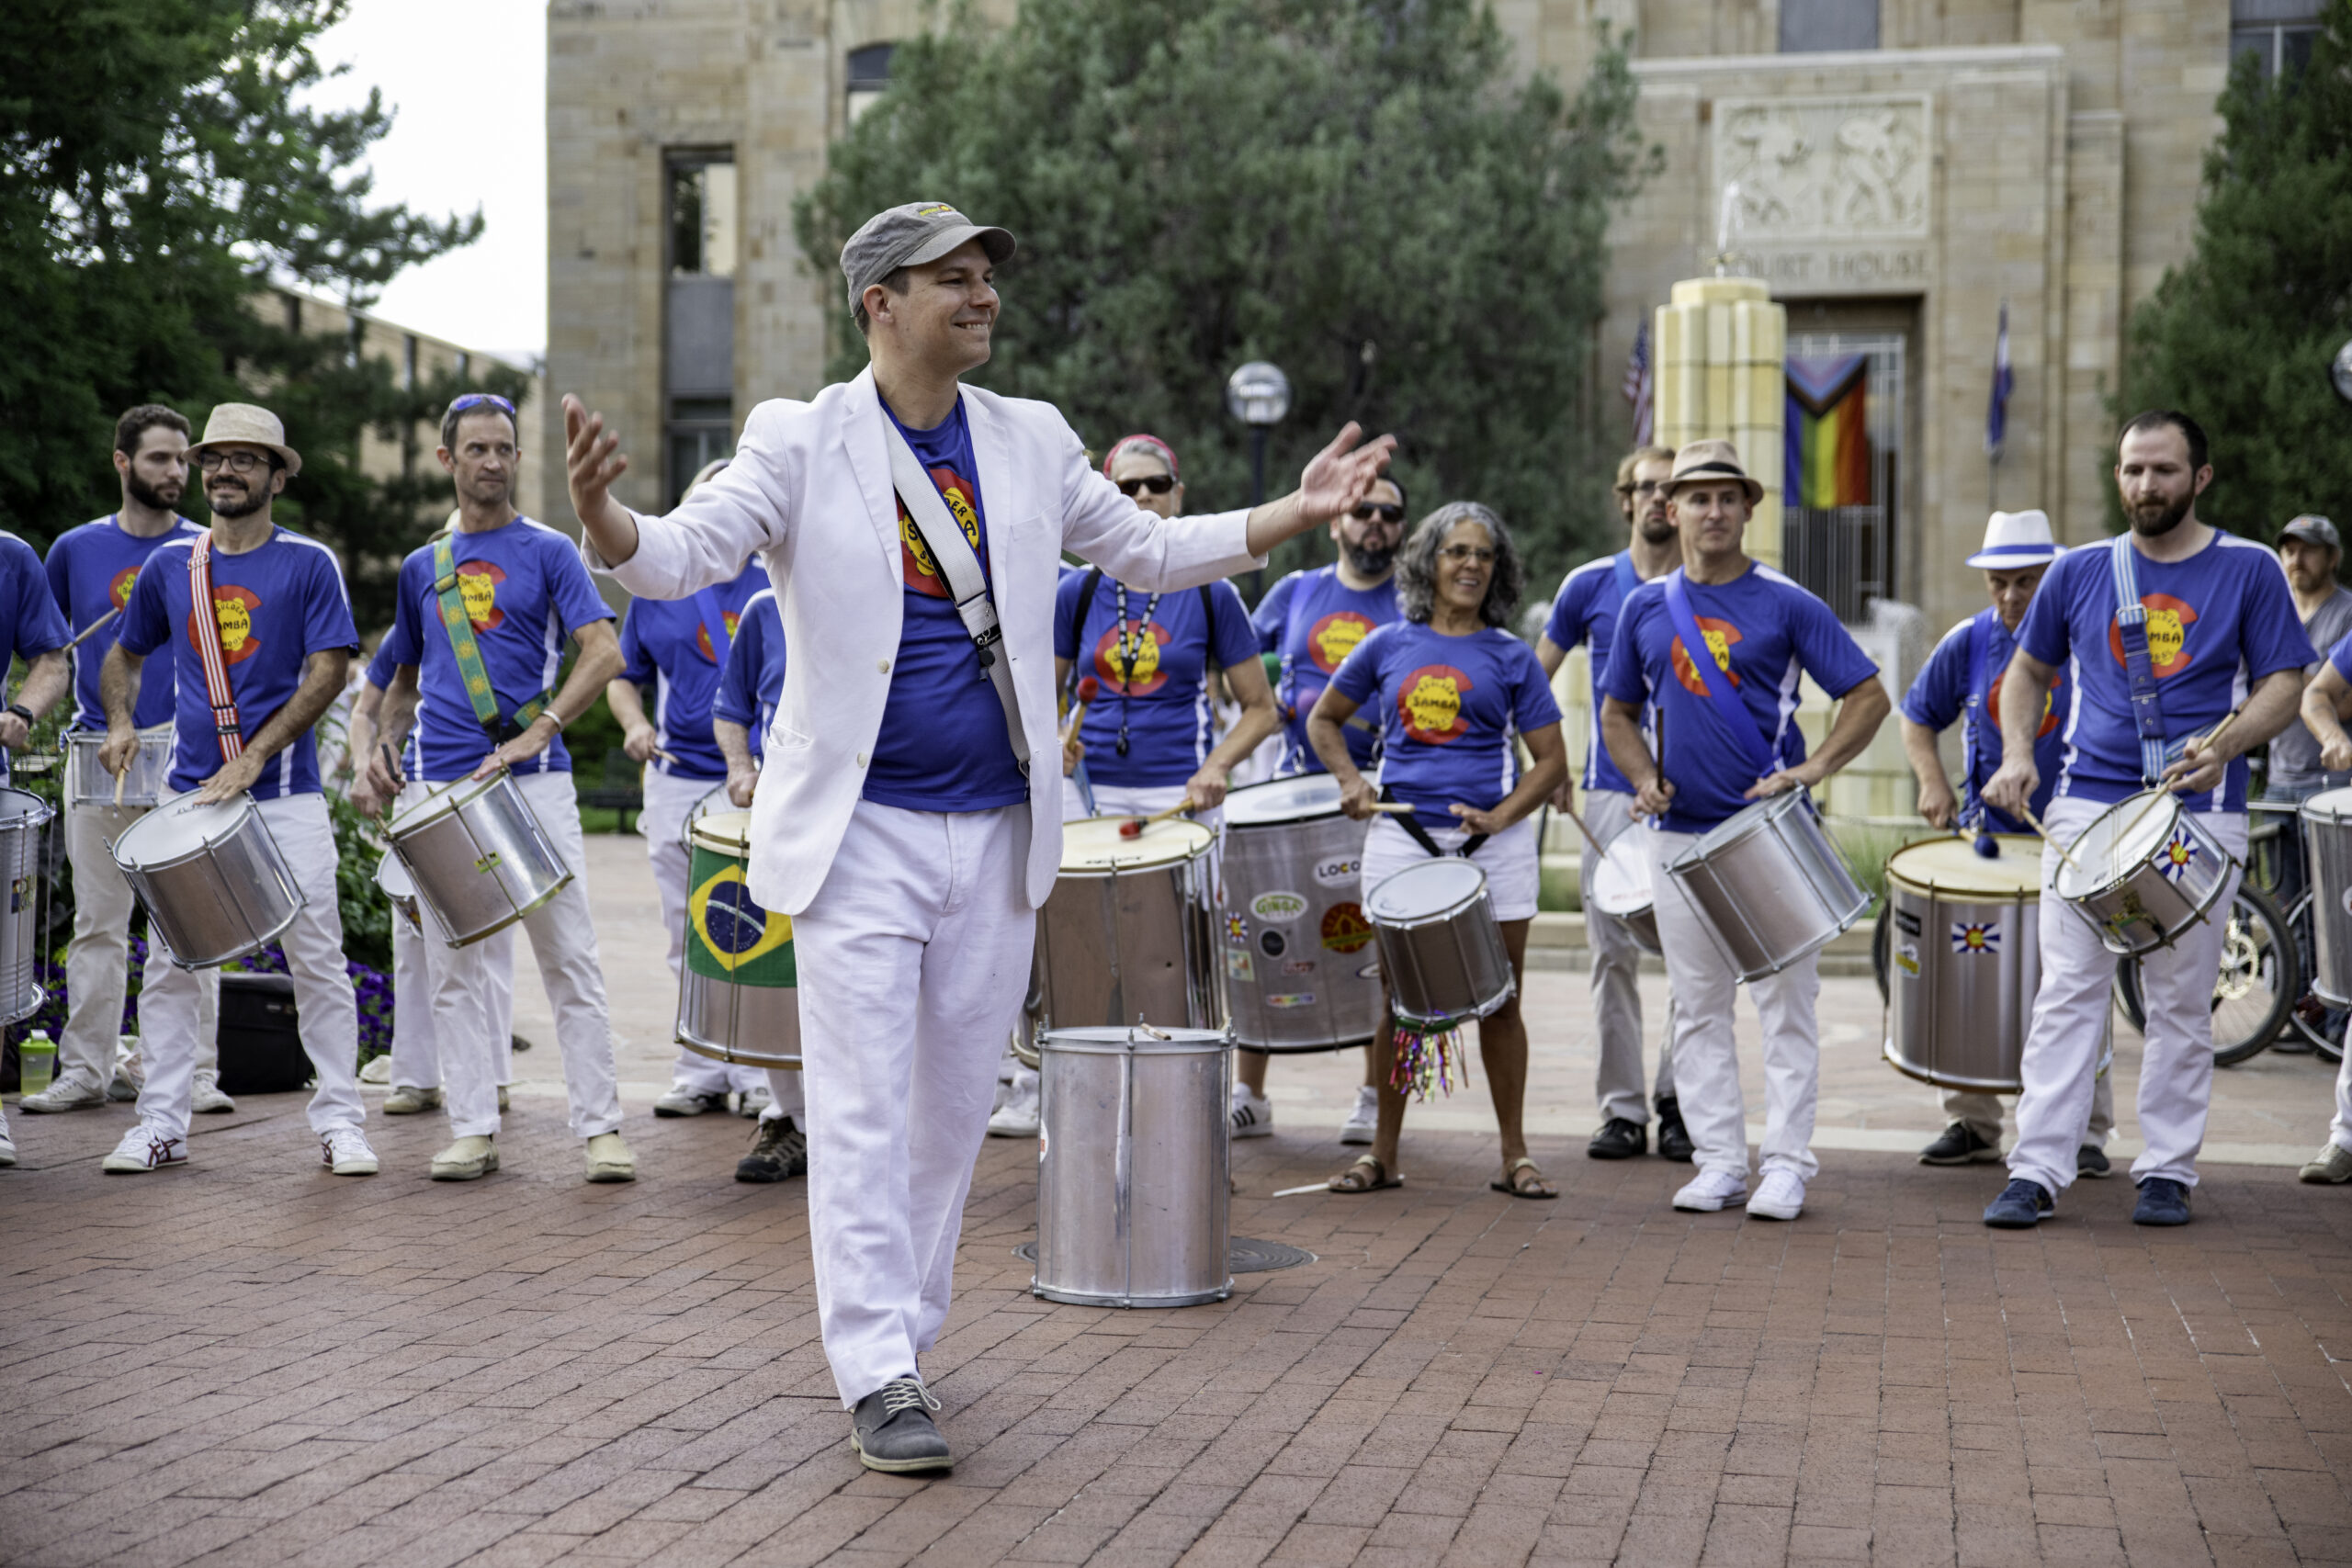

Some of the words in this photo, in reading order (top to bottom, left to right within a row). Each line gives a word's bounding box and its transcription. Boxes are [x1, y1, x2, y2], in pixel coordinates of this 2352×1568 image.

[1828, 250, 1931, 278] HOUSE
[216, 603, 245, 616] OULDER
[2149, 631, 2182, 644] MBA
[1413, 696, 1458, 710] SAMBA
[1318, 860, 1361, 877] LOCO
